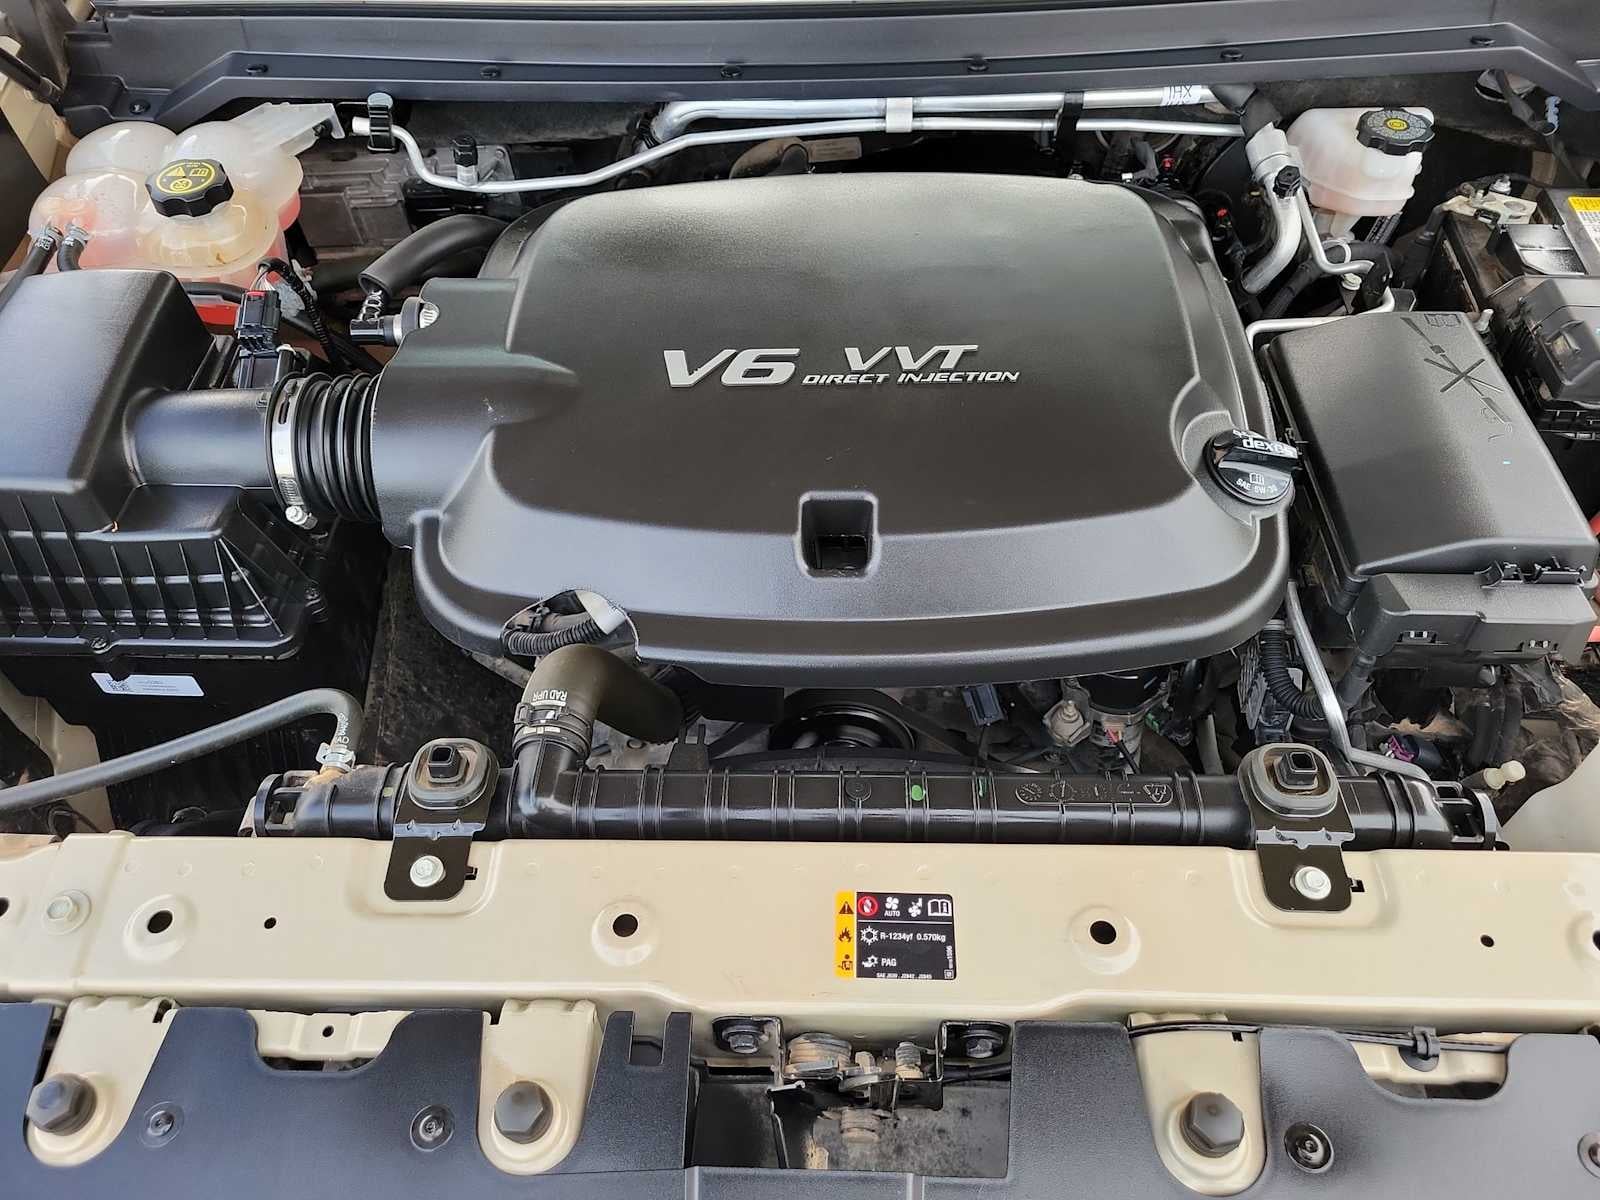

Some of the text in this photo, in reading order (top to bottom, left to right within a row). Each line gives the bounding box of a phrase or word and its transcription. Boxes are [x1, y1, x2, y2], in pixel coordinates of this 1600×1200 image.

[844, 344, 979, 371] VVT
[662, 348, 800, 387] V6
[802, 370, 1021, 385] DIRECT INJECTION
[880, 932, 946, 943] R-1234yf 0.570kg
[881, 958, 897, 967] PAG
